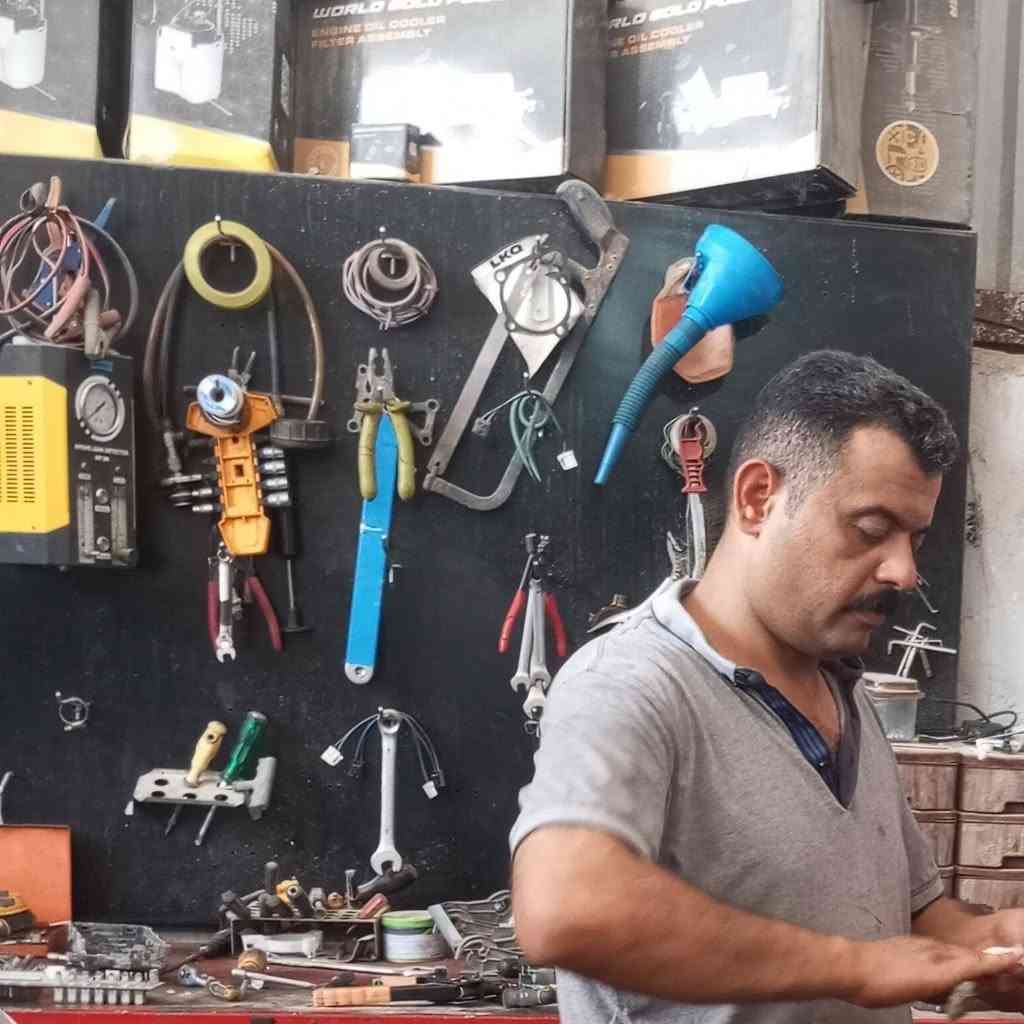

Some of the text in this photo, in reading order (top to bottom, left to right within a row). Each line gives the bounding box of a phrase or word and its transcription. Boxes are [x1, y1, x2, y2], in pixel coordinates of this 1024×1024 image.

[312, 0, 385, 19] WORLD
[311, 15, 447, 36] ENGINE OIL COOLER
[607, 11, 648, 30] RLD
[627, 33, 648, 44] OIL
[650, 20, 704, 39] COOLER
